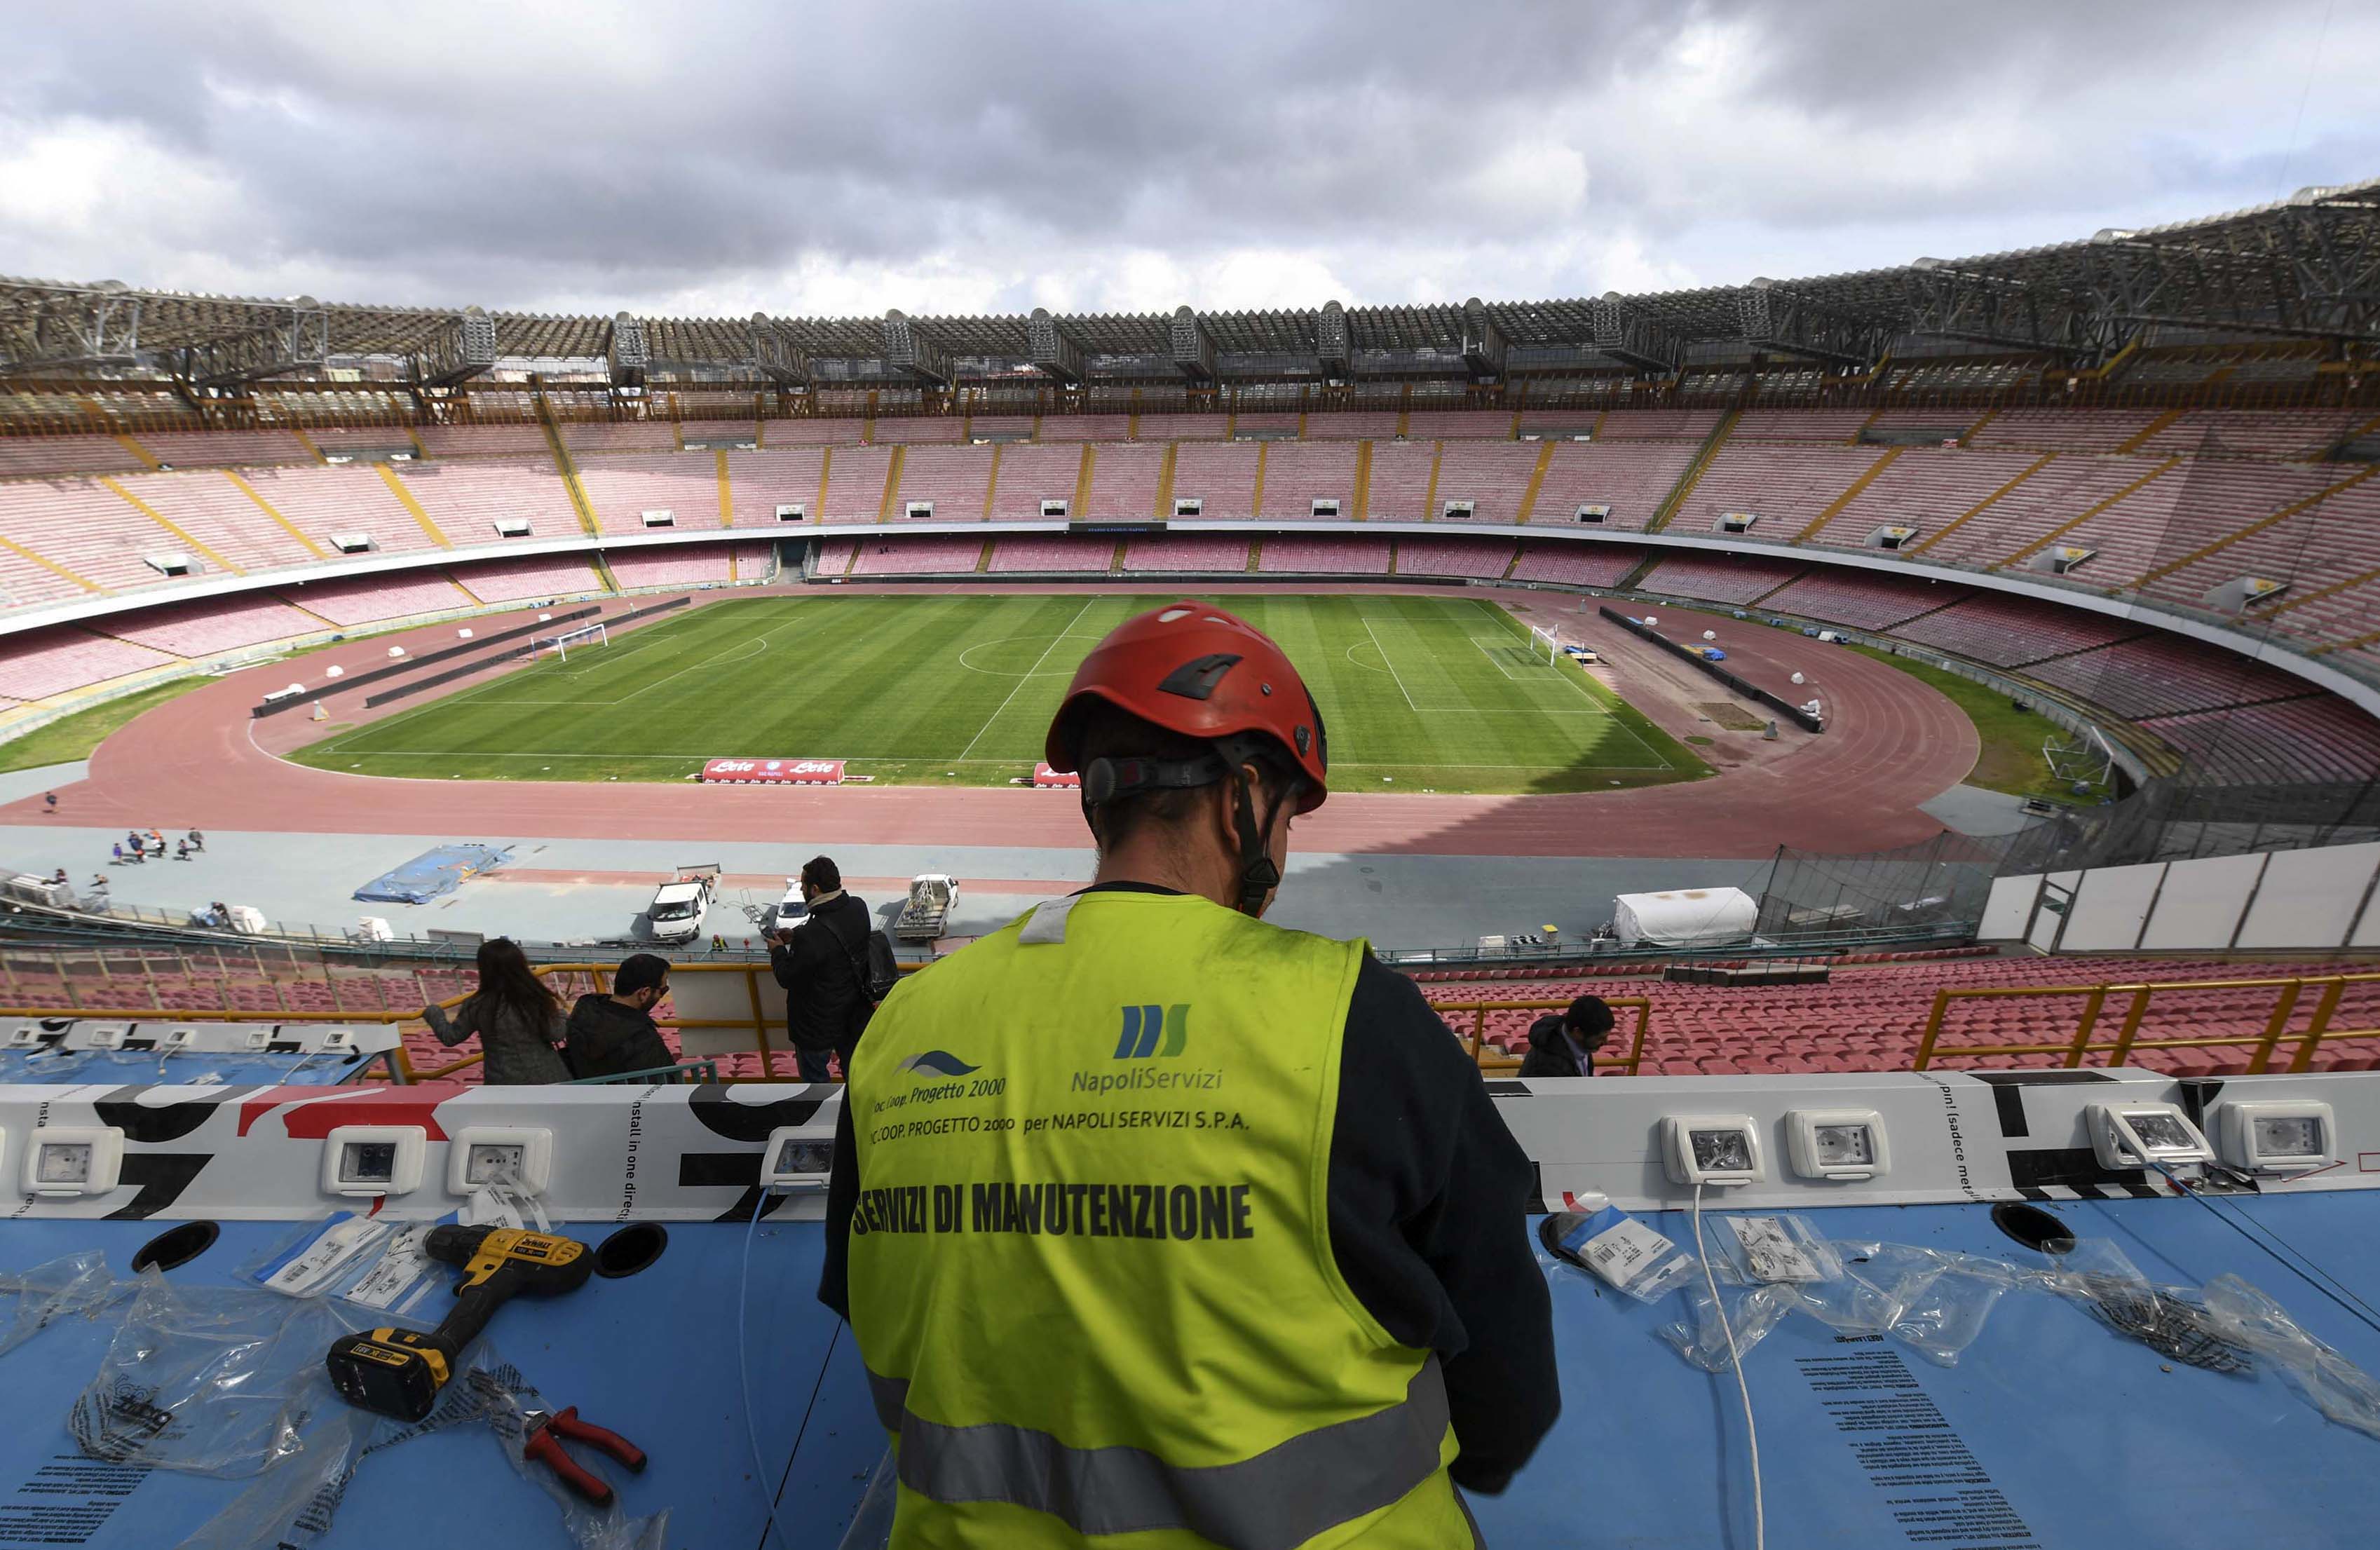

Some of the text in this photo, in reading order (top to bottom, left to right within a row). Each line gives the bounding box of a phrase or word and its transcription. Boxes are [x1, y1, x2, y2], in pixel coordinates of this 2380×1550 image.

[711, 761, 754, 772] Lete
[790, 762, 834, 773] Lete
[910, 1082, 965, 1104] Progetto
[968, 1077, 1006, 1097] 2000
[1071, 1067, 1223, 1096] NapoliServizi
[909, 1116, 979, 1136] PROGETTO
[983, 1118, 1016, 1131] 2000
[1024, 1117, 1049, 1135] per
[1051, 1112, 1114, 1129] NAPOLI
[1118, 1111, 1190, 1128] SERVIZI
[1195, 1111, 1249, 1130] S.P.A.
[627, 1141, 640, 1152] in
[626, 1155, 637, 1179] one
[1958, 1165, 1985, 1201] metali
[616, 1183, 637, 1222] directi
[852, 1183, 1253, 1240] SERVIZI DI MANUTENZIONE
